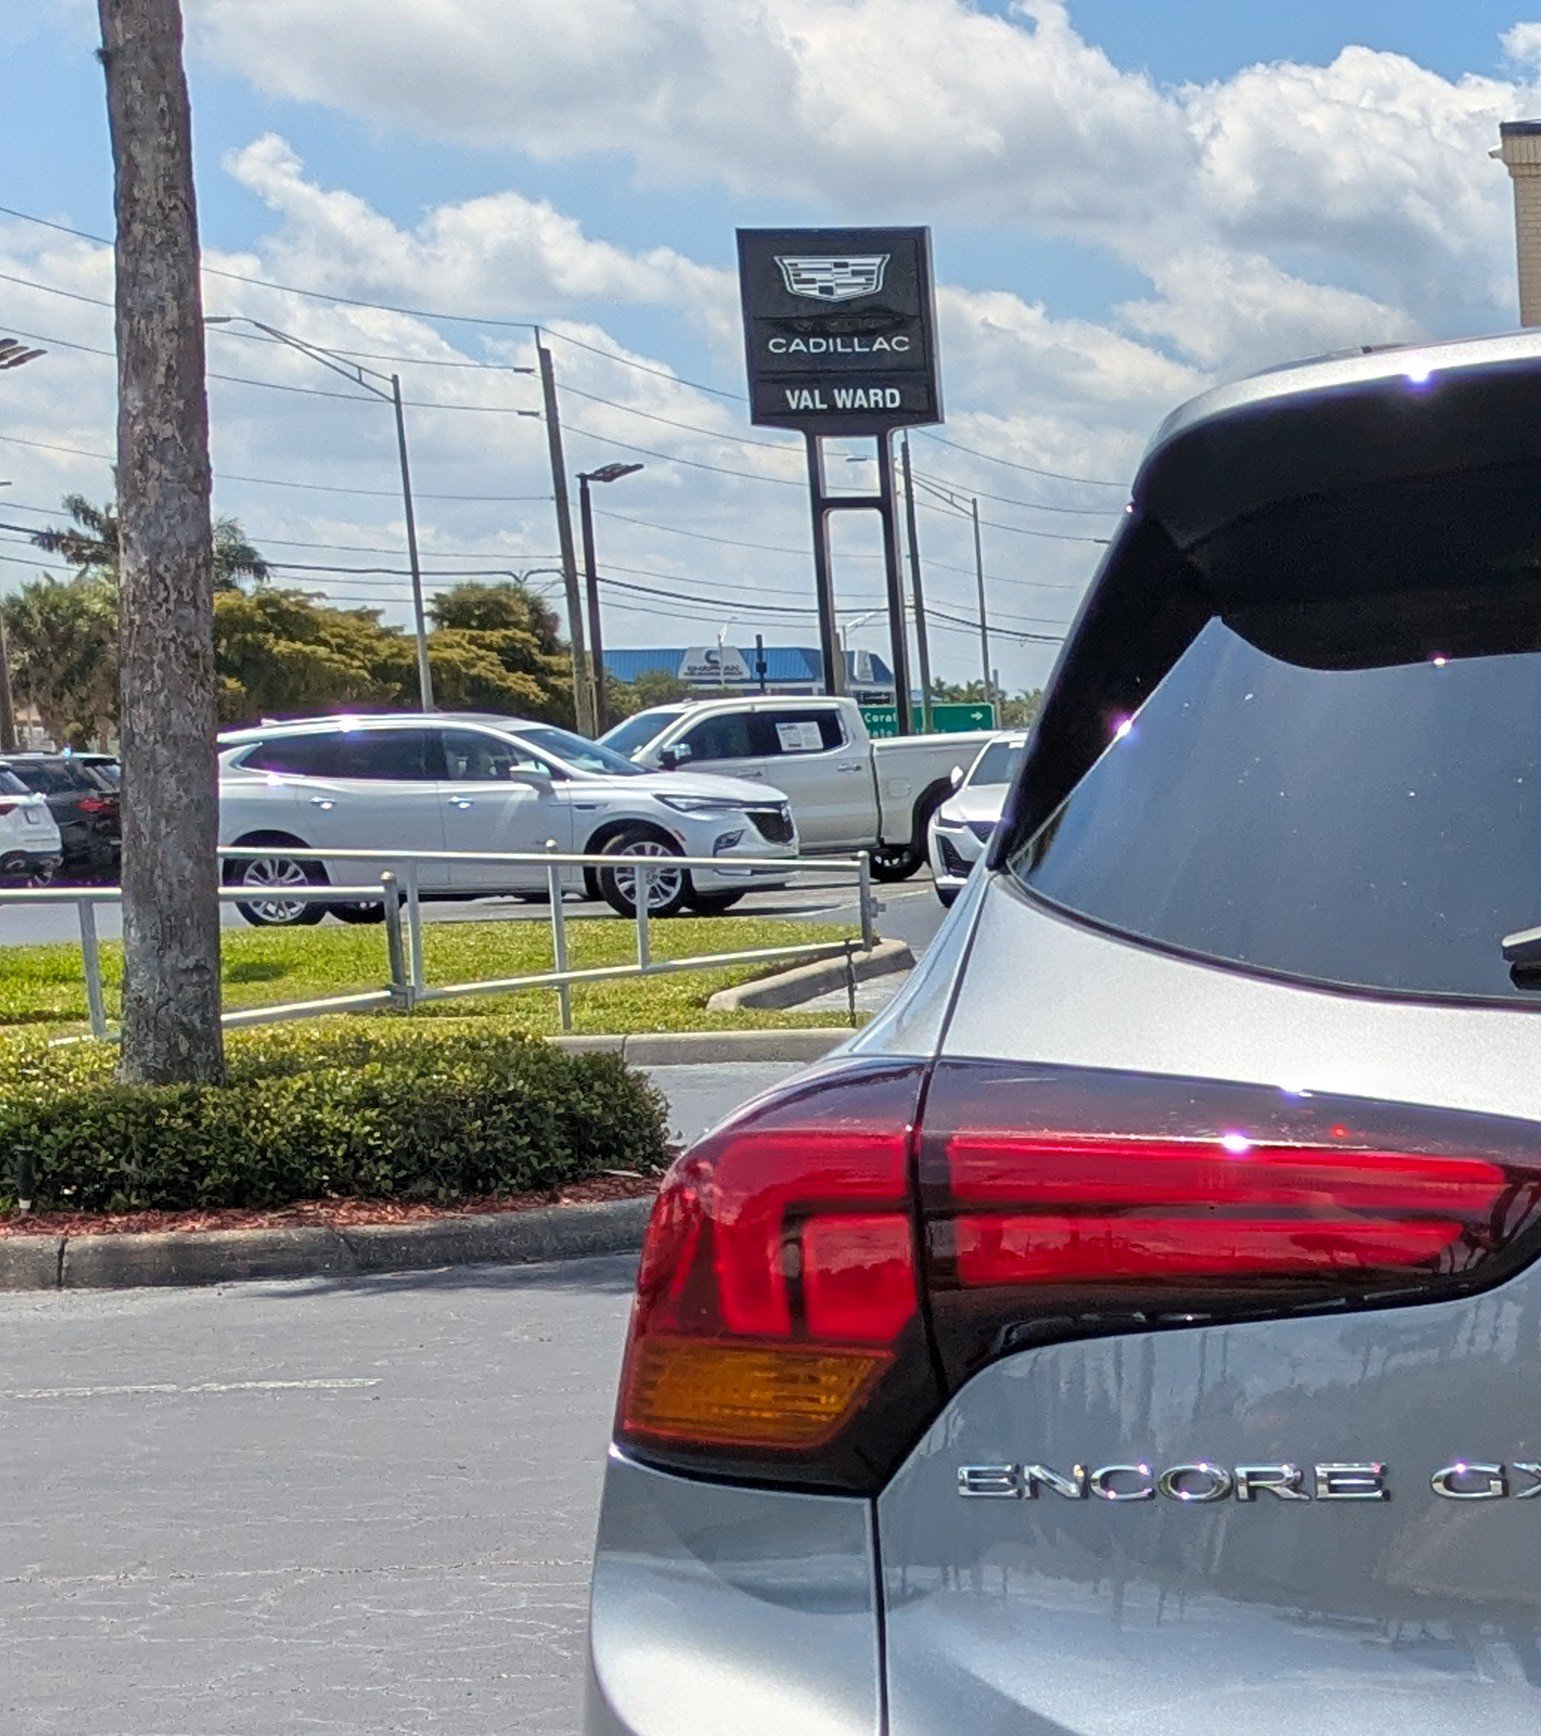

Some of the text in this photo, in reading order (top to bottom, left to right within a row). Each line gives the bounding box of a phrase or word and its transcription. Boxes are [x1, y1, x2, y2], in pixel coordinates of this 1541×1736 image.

[768, 336, 911, 354] CADILLAC
[785, 388, 901, 410] VAL WARD
[957, 1462, 1392, 1502] ENCORE
